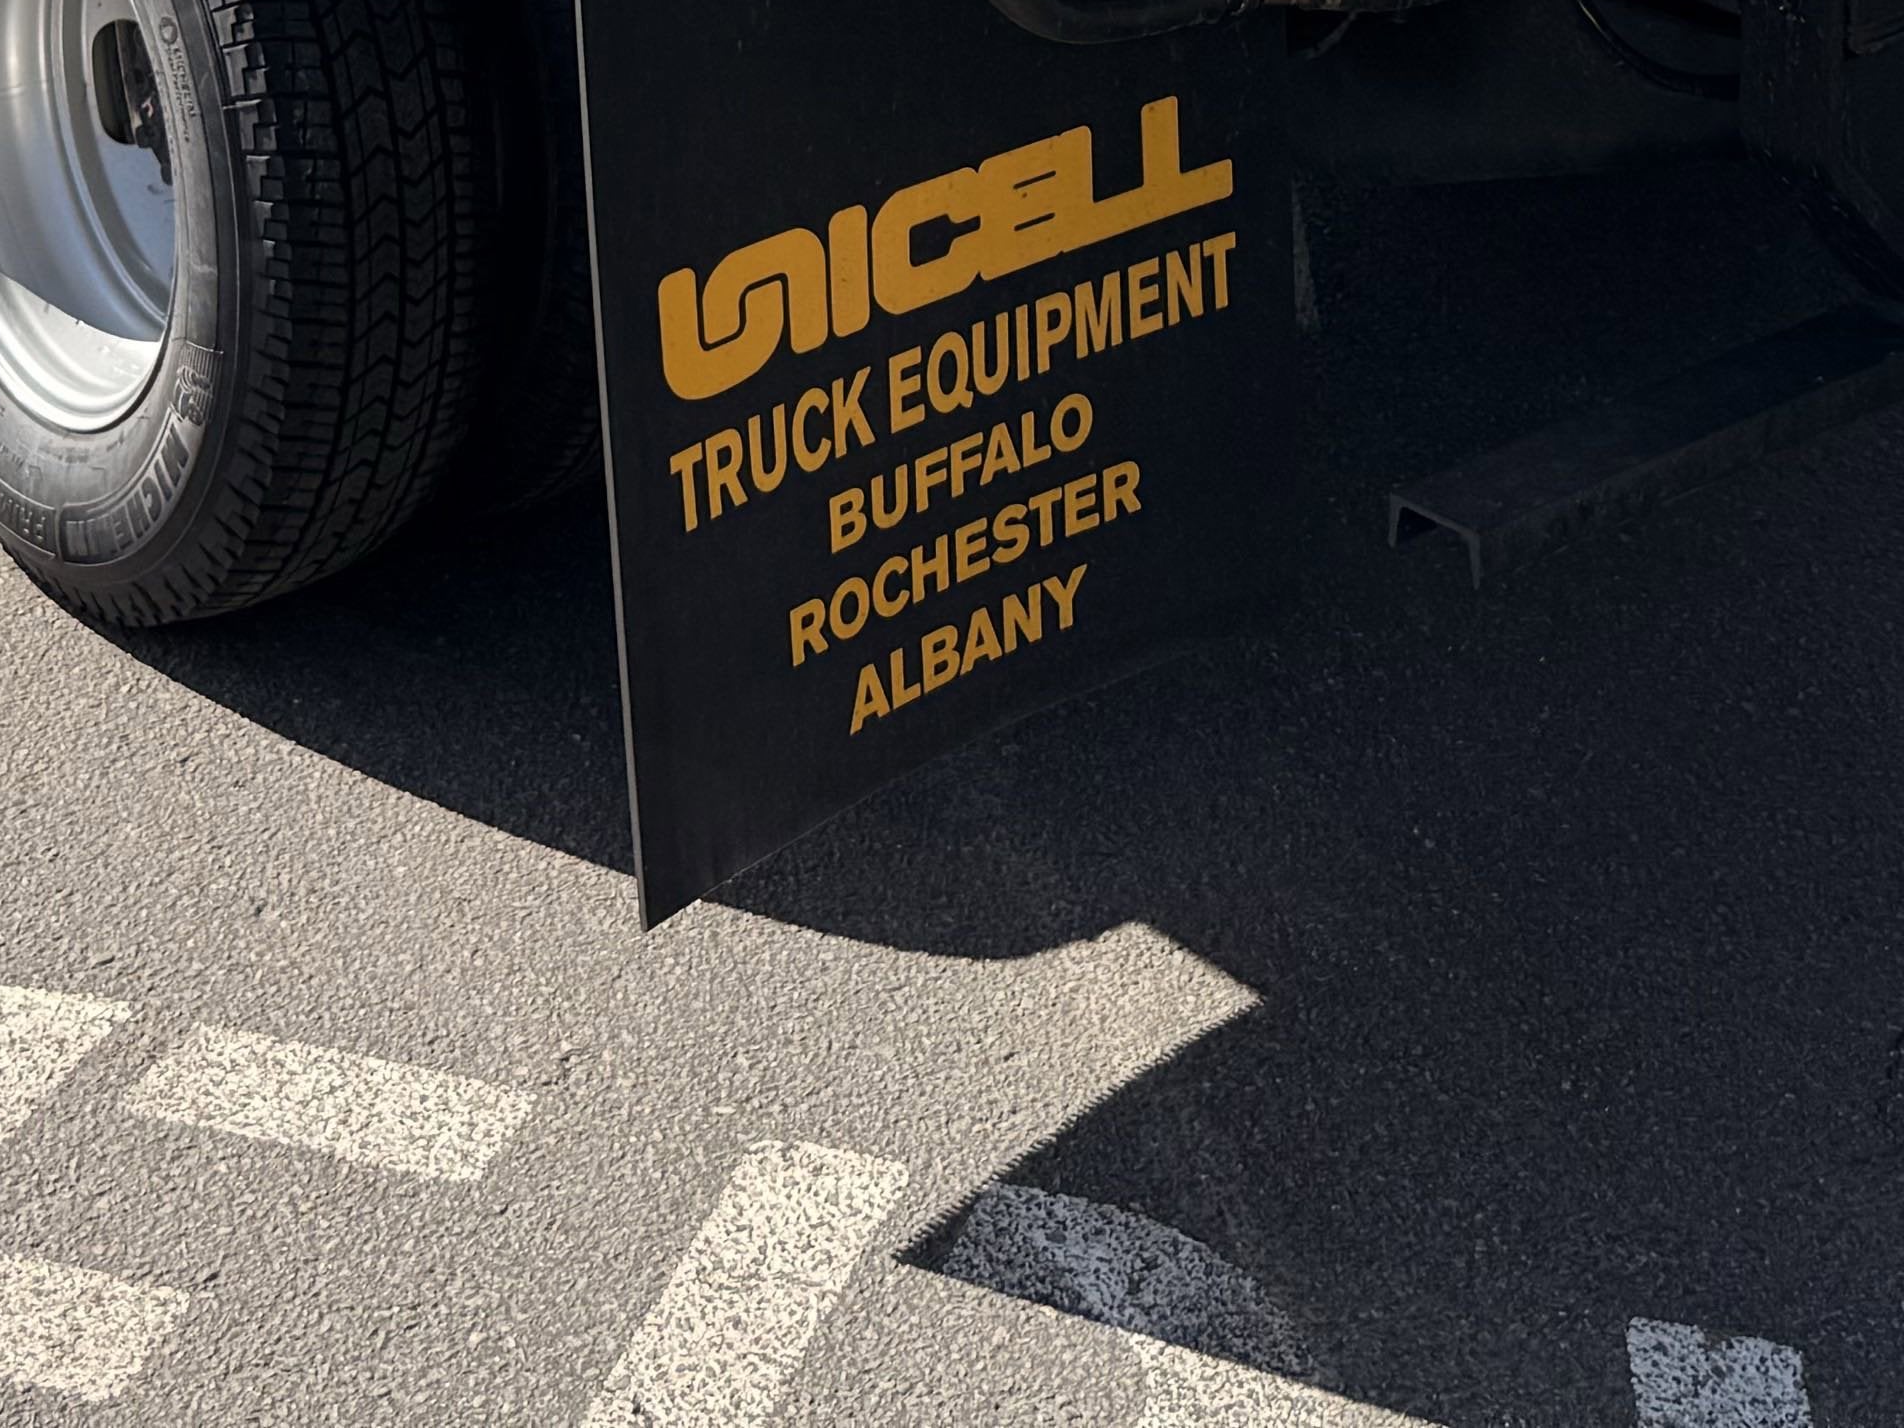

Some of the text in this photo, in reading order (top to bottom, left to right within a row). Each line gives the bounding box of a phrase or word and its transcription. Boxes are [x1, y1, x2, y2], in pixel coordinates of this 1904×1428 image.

[657, 96, 1233, 401] UNICELL
[670, 232, 1237, 531] TRUCK EQUIPMENT
[829, 394, 1093, 553] BUFFALO
[789, 462, 1141, 666] ROCHESTER
[851, 566, 1085, 733] ALBANY
